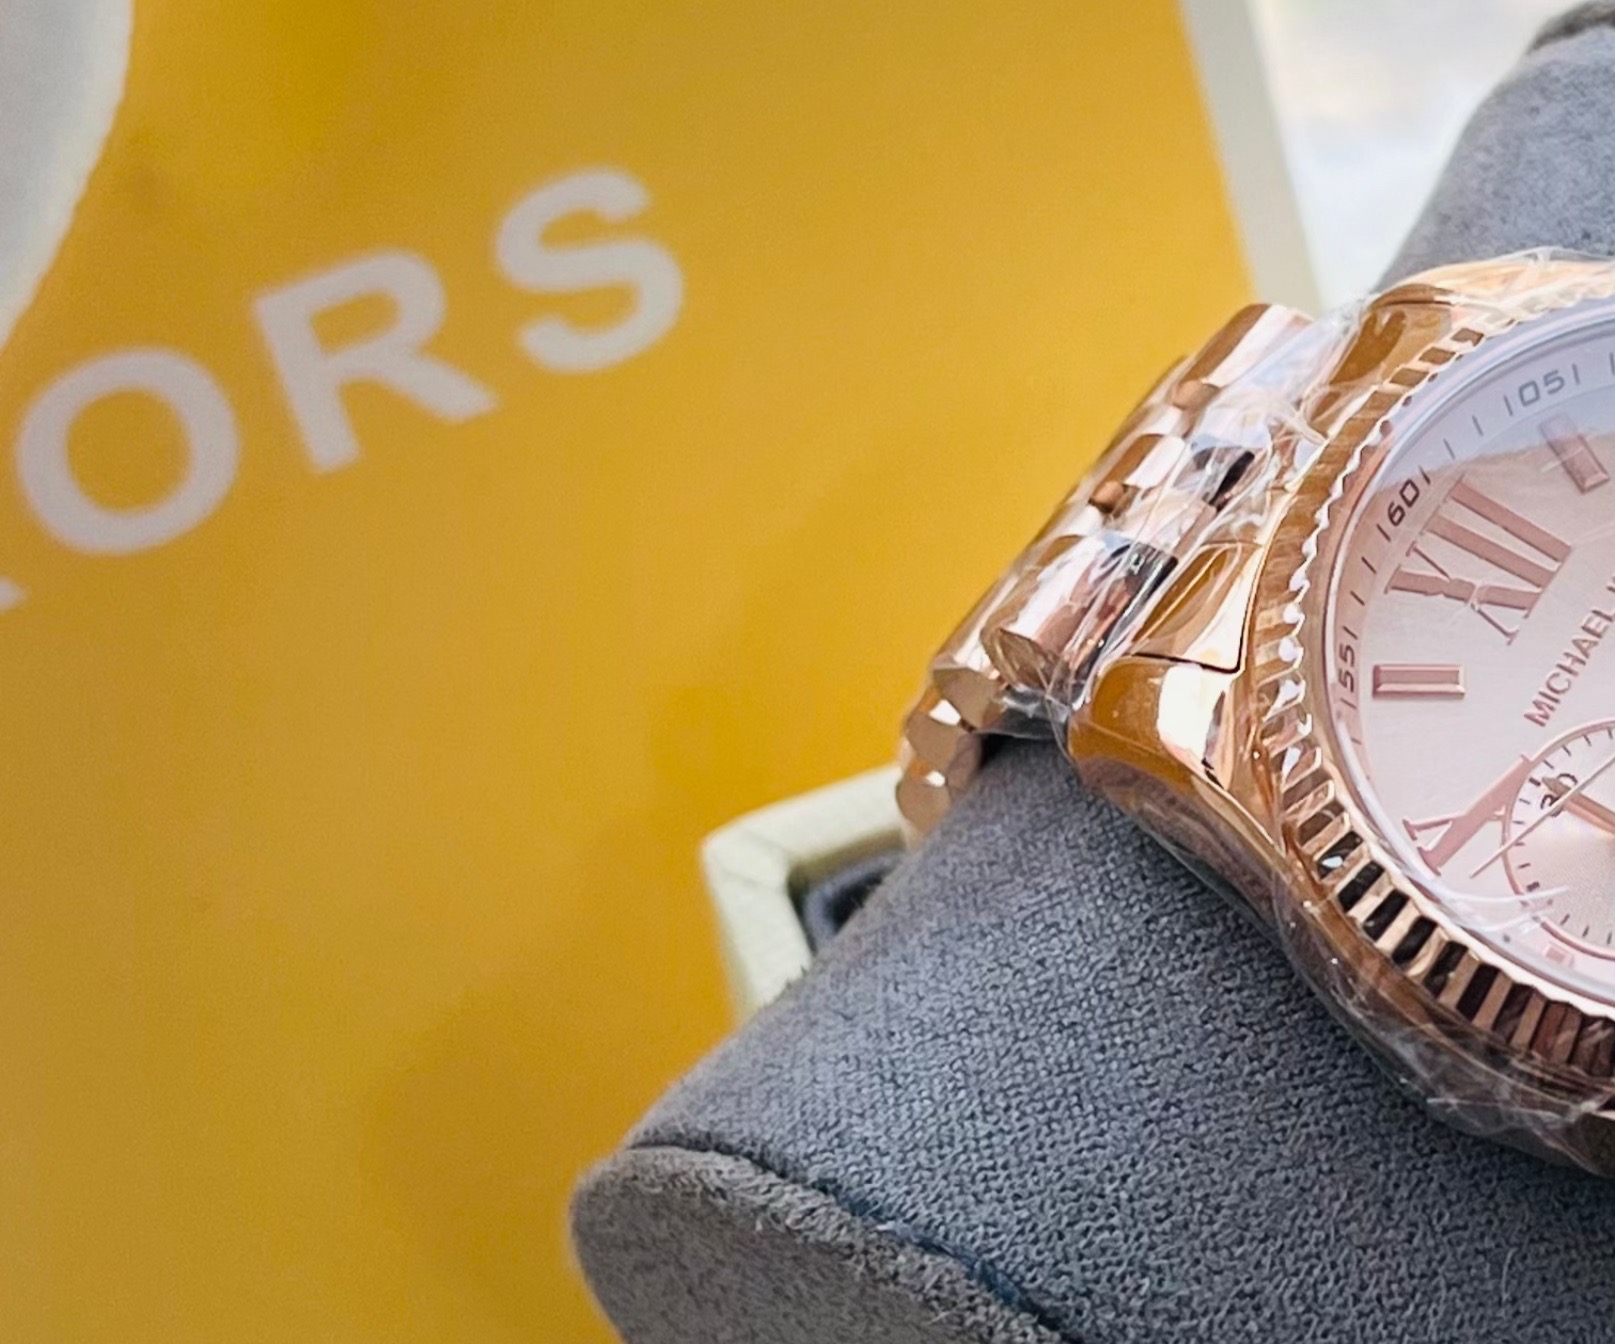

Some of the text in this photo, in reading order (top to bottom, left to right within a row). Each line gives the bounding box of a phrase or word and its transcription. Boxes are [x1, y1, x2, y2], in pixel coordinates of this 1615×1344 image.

[0, 163, 686, 611] ORS
[1518, 369, 1566, 408] 05
[1387, 478, 1421, 527] 60
[1383, 472, 1574, 646] XII
[1337, 643, 1356, 694] 55
